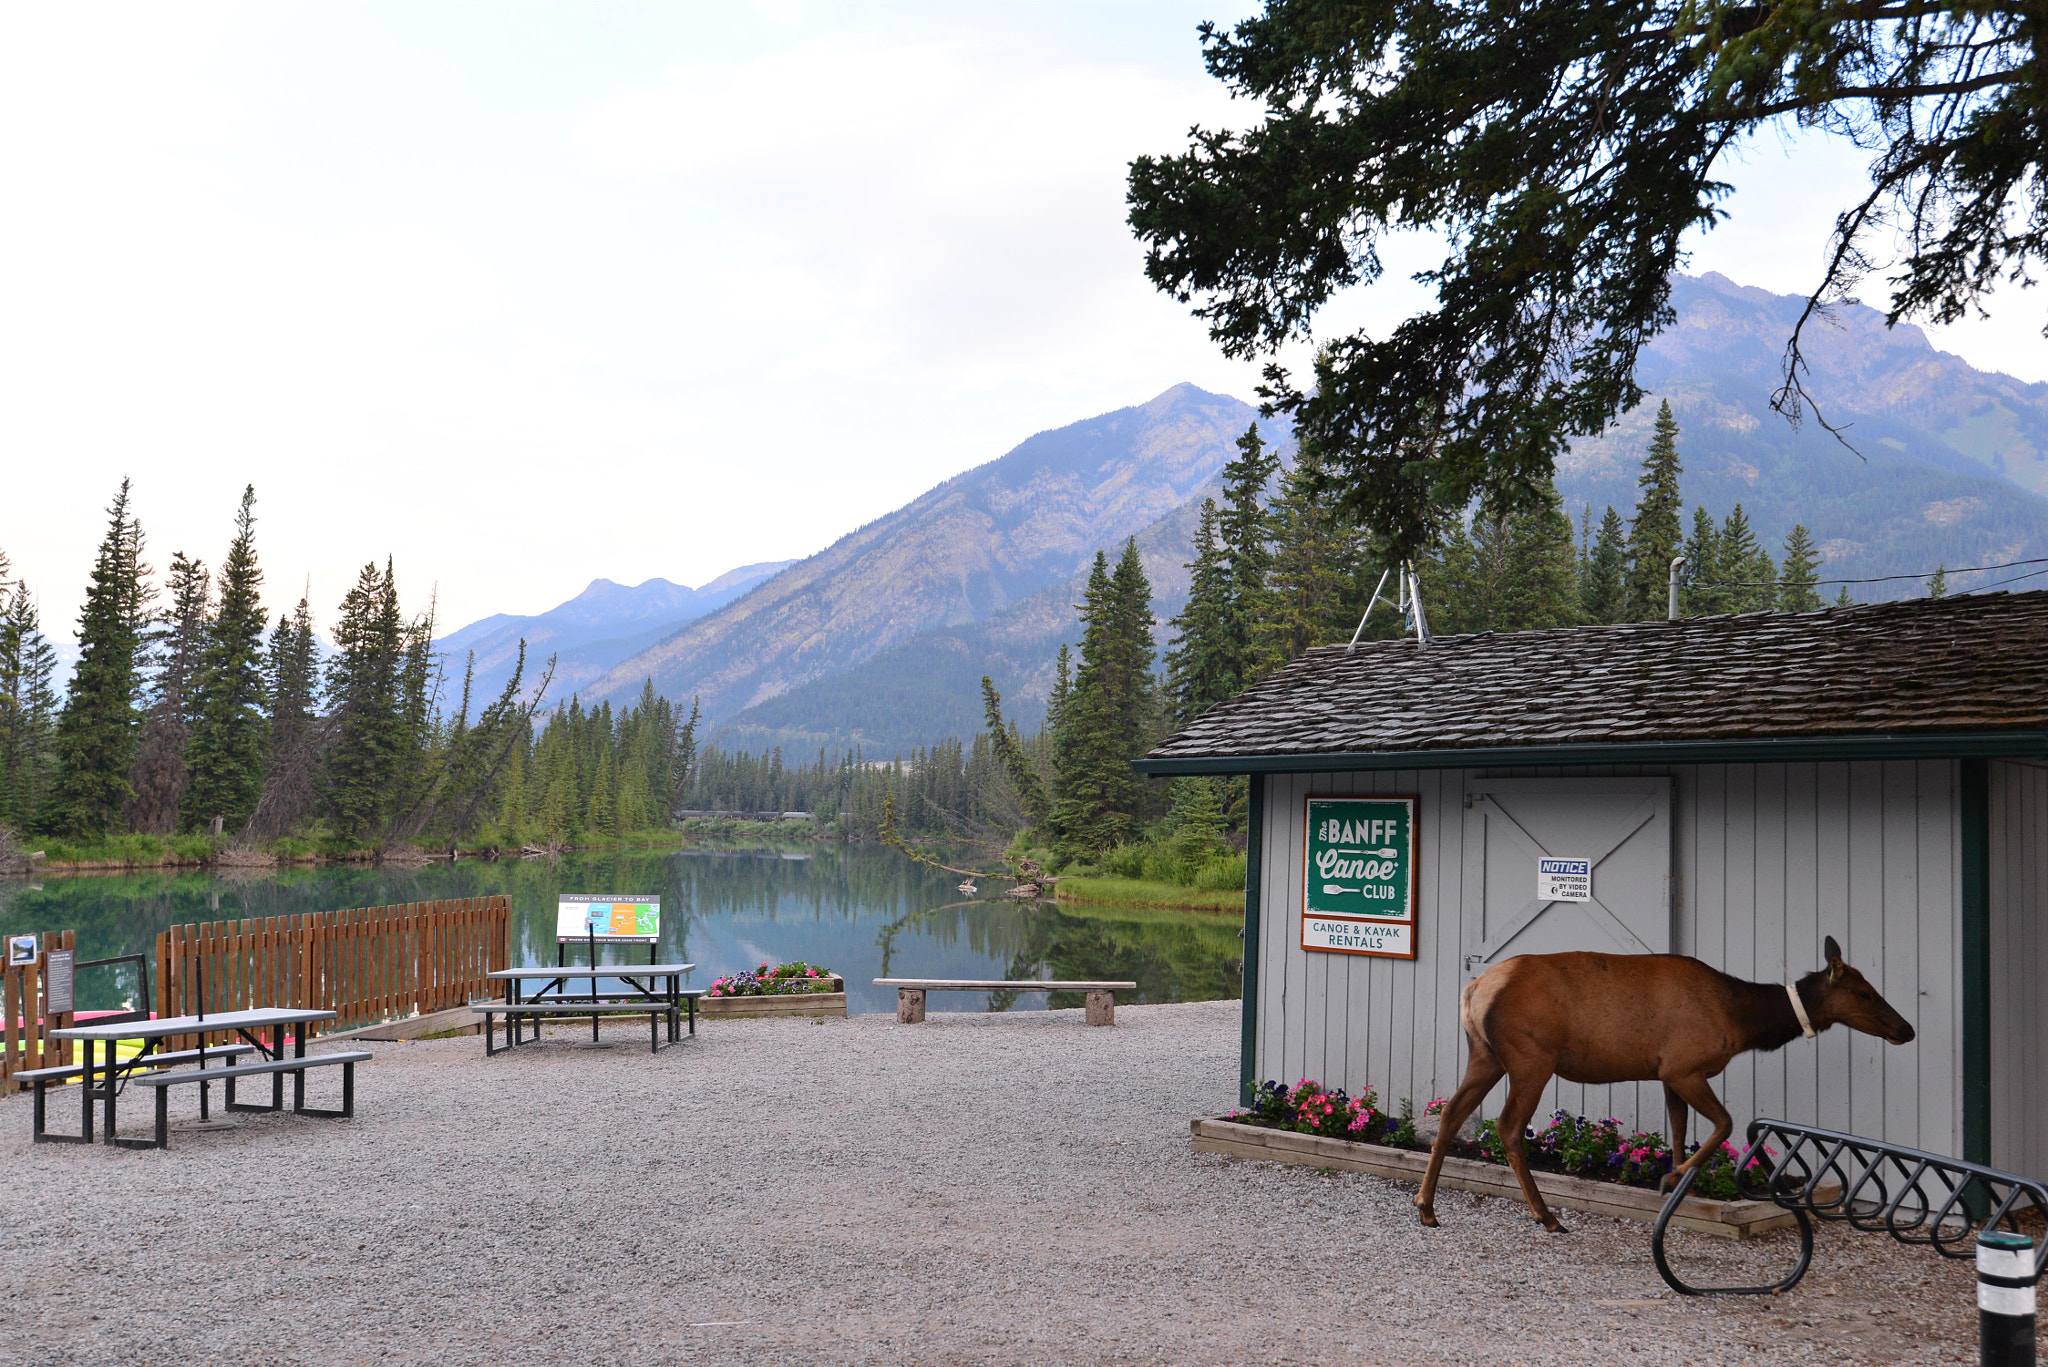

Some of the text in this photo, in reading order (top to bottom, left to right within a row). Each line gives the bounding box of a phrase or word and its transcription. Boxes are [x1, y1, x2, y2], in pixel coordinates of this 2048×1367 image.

[1318, 818, 1397, 845] The BANFF
[1315, 848, 1396, 881] Canoe
[1542, 861, 1587, 873] NOTICE
[1363, 884, 1396, 900] CLUB
[1313, 922, 1400, 938] CANOE & KAYAK
[1329, 934, 1383, 949] RENTALS
